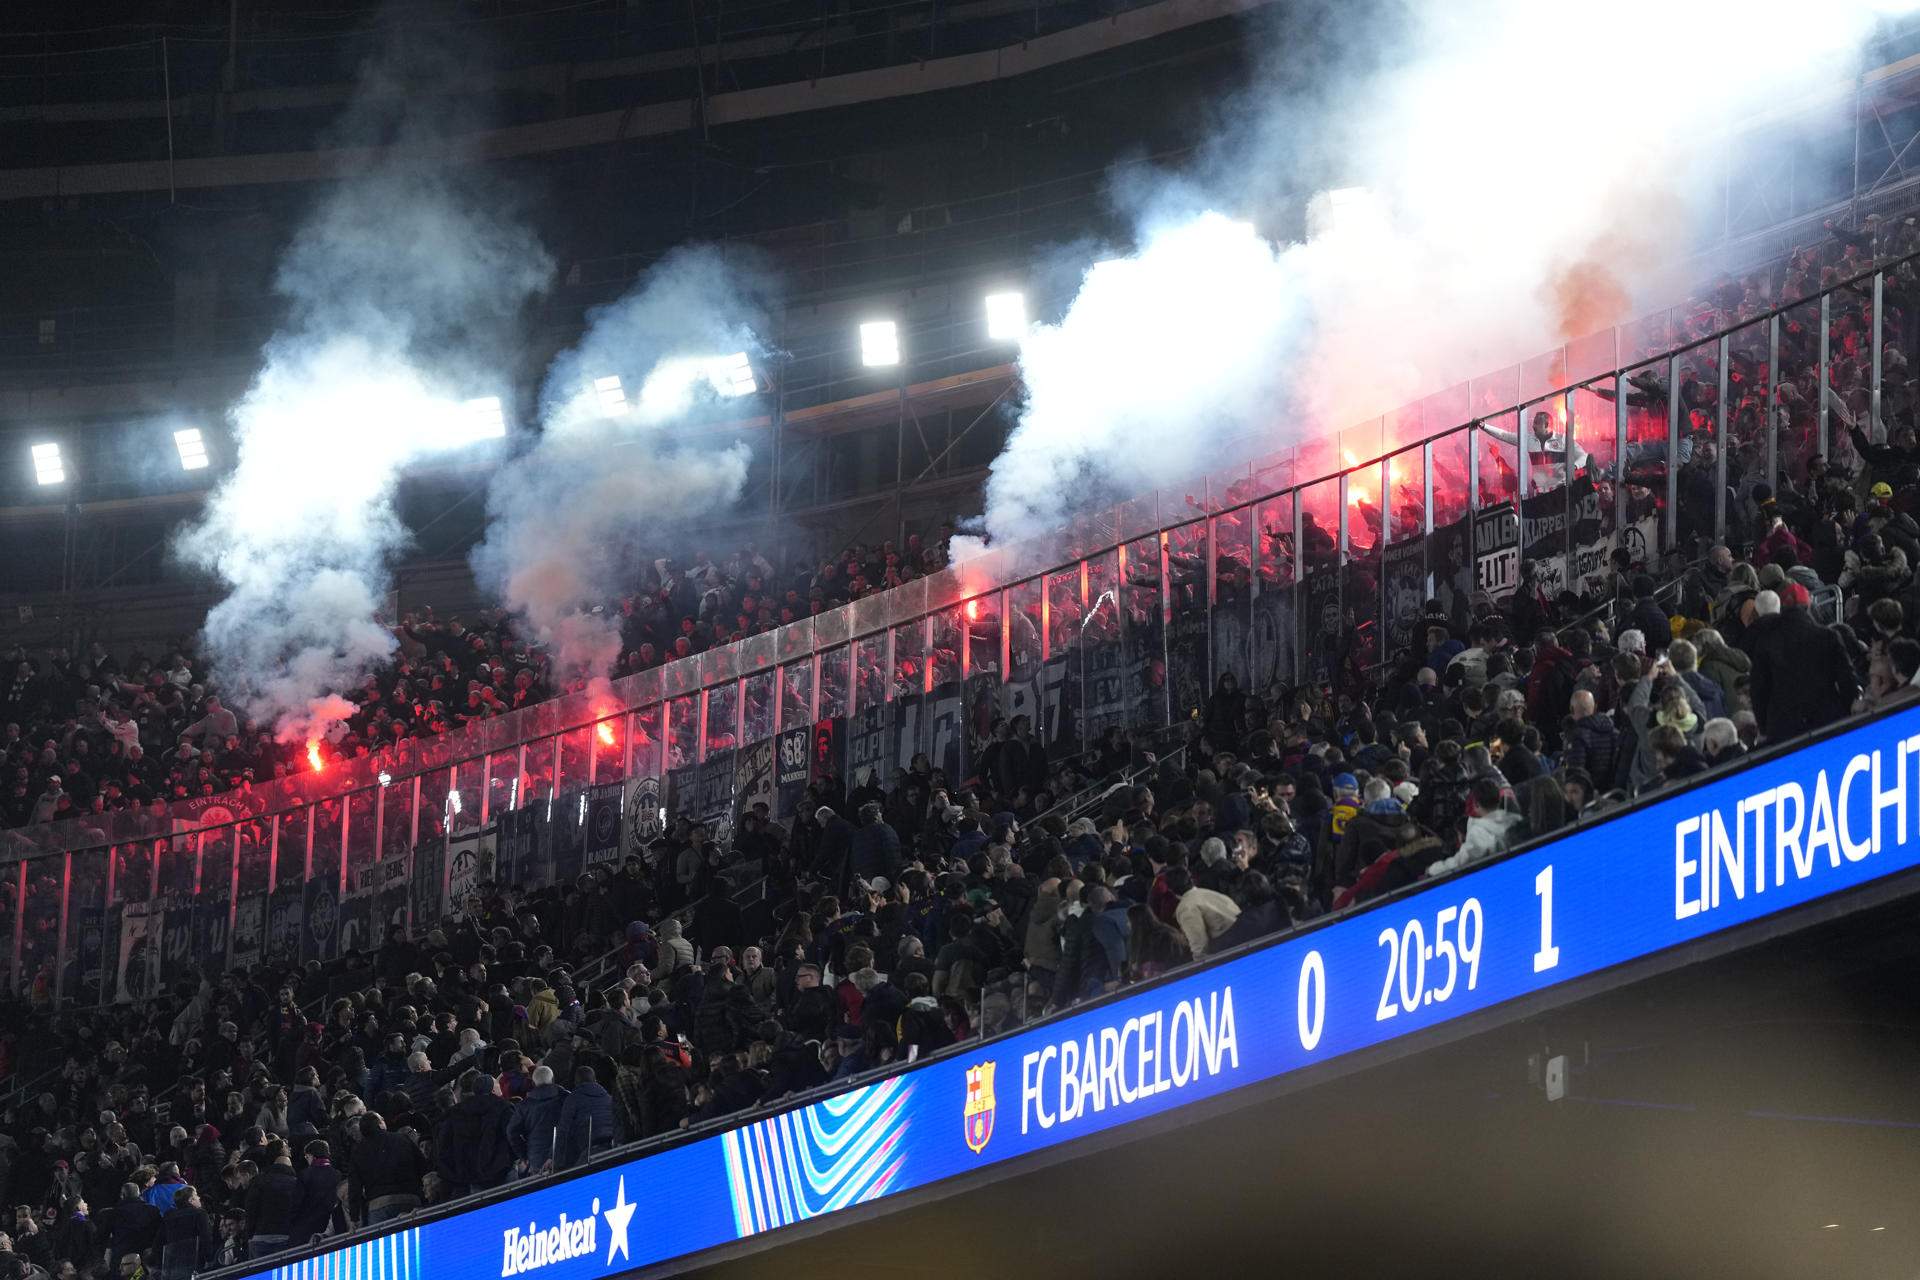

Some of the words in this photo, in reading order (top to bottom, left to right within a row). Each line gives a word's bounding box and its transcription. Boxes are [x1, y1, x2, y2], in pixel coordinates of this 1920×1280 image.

[1375, 897, 1483, 1022] 20:59
[1534, 865, 1560, 973] 1
[1297, 950, 1326, 1051] 0
[1021, 1045, 1057, 1135] FC
[1059, 985, 1239, 1124] BARCELONA
[501, 1211, 598, 1279] Heineken
